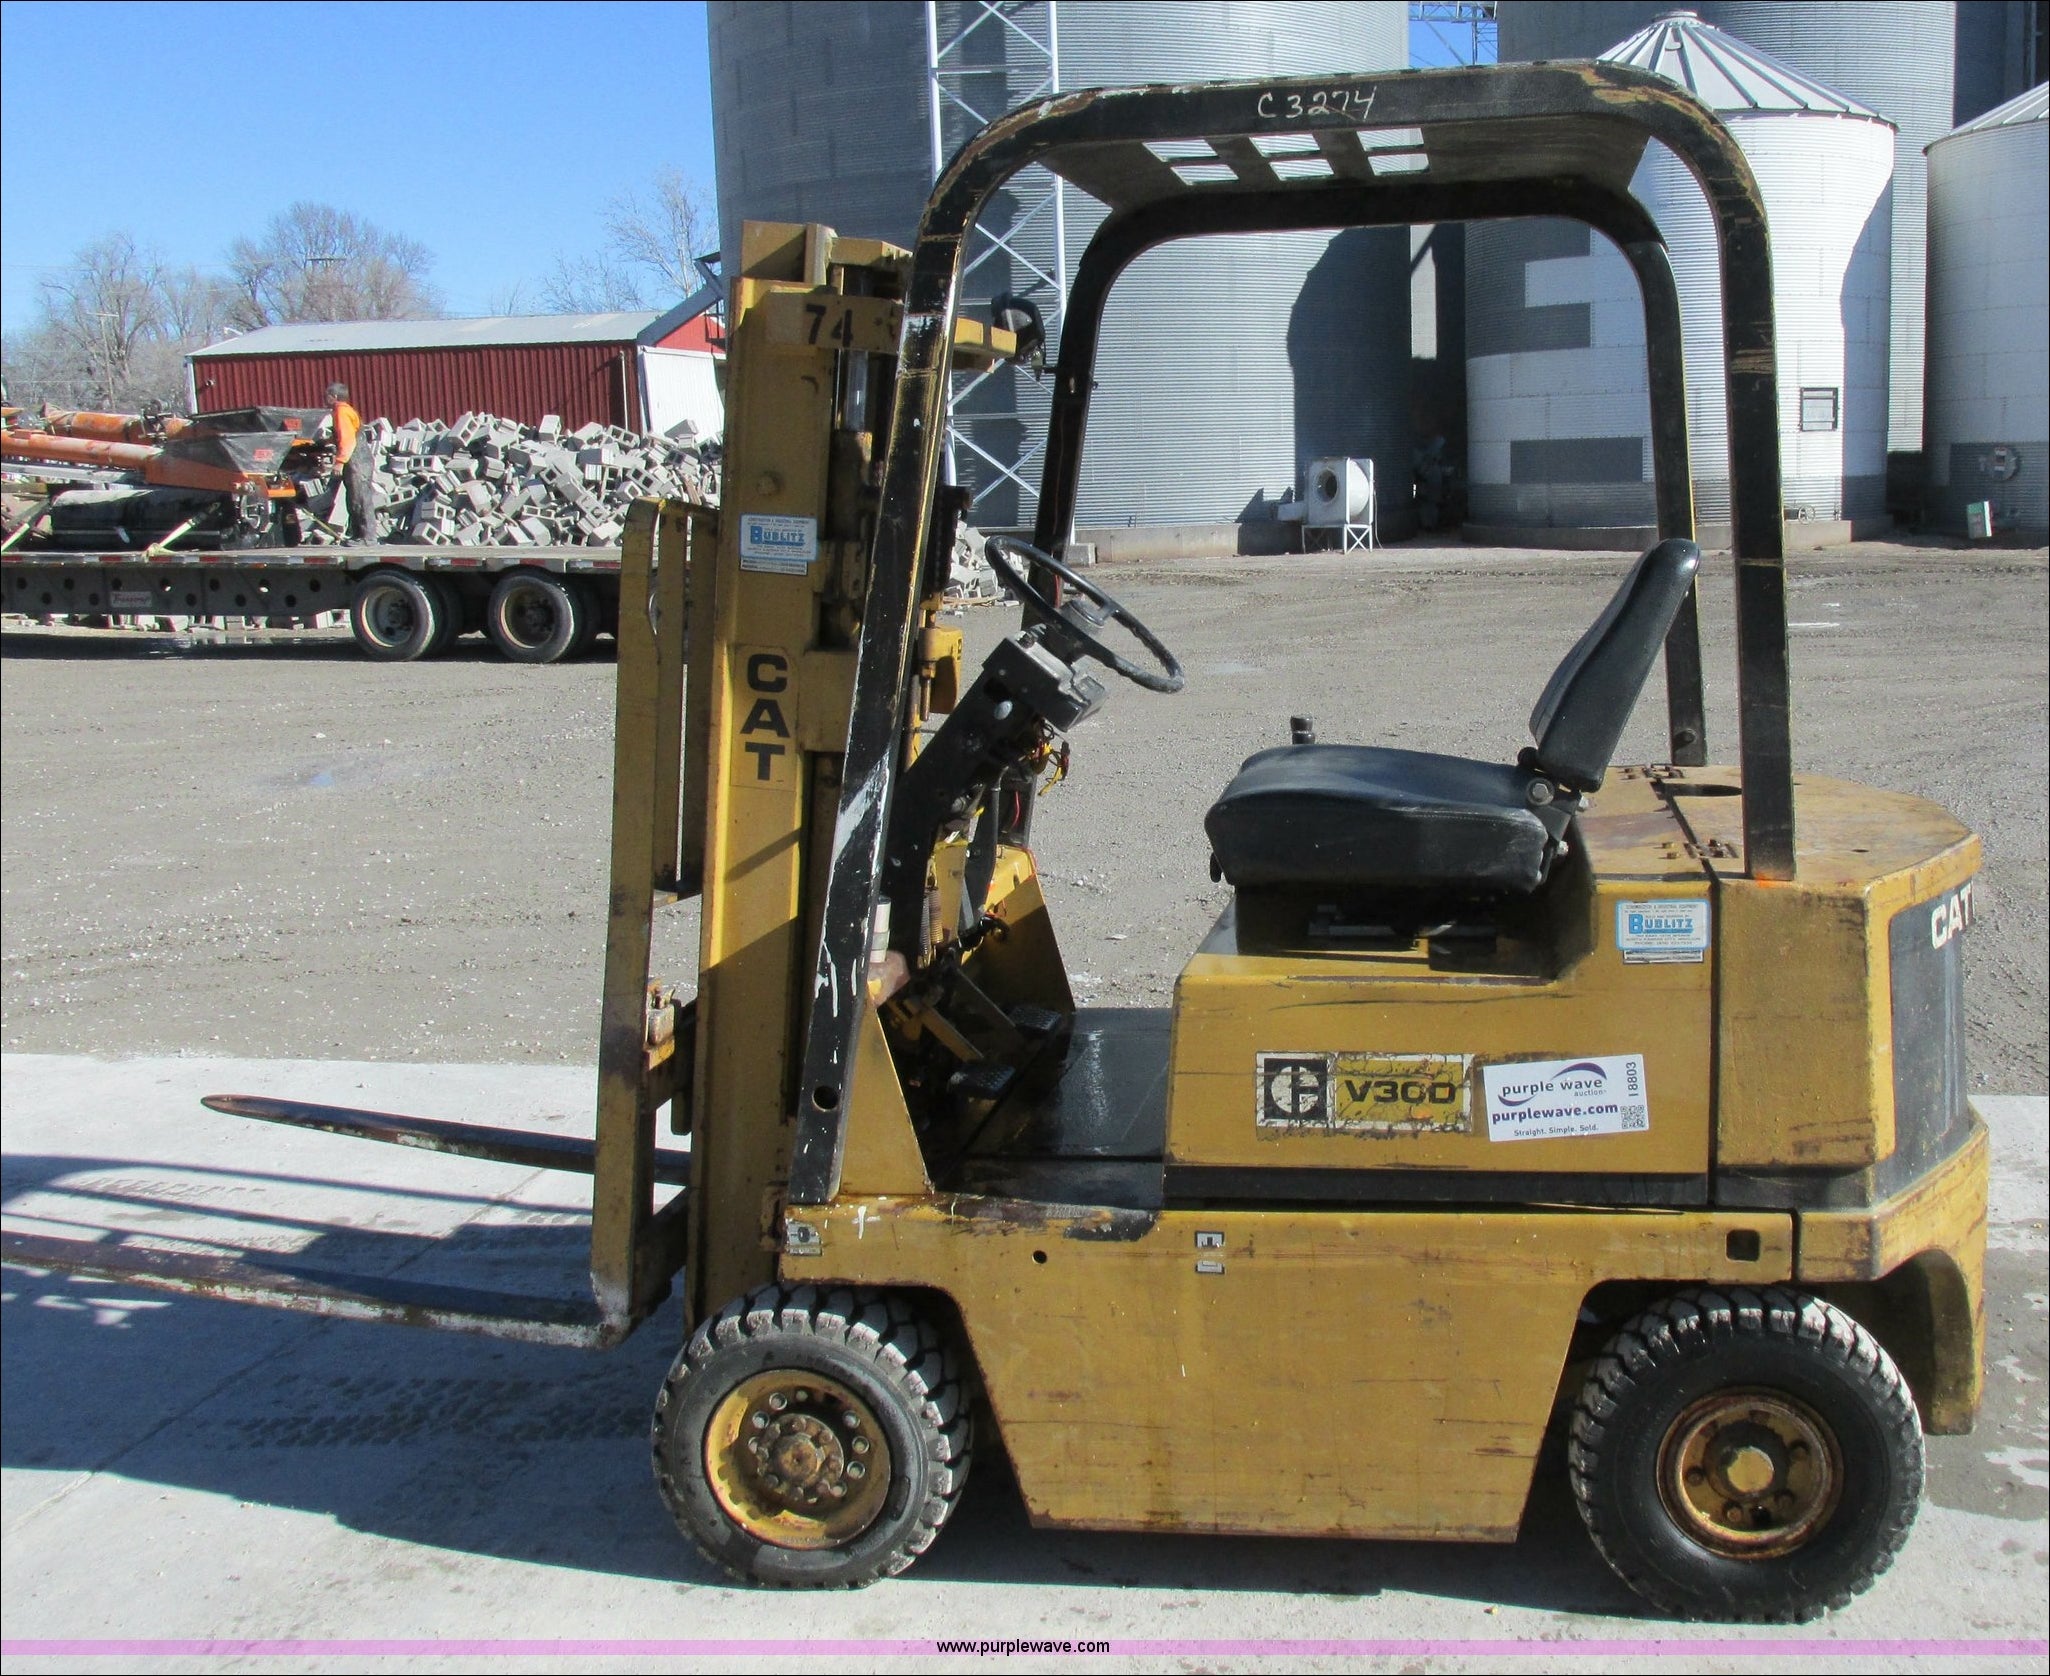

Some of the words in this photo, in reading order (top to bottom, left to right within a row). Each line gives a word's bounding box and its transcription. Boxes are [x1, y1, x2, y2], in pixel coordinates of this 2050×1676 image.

[740, 653, 791, 781] CAT
[1628, 913, 1693, 935] BUBLITZ
[1931, 881, 1974, 950] CAT
[1502, 1081, 1554, 1097] purple
[1560, 1079, 1603, 1090] wave
[1625, 1061, 1639, 1097] 18803
[1492, 1104, 1619, 1125] purplewave.com
[1514, 1129, 1546, 1137] Straight.
[1549, 1126, 1577, 1135] Simple.
[1579, 1124, 1599, 1132] Sold.
